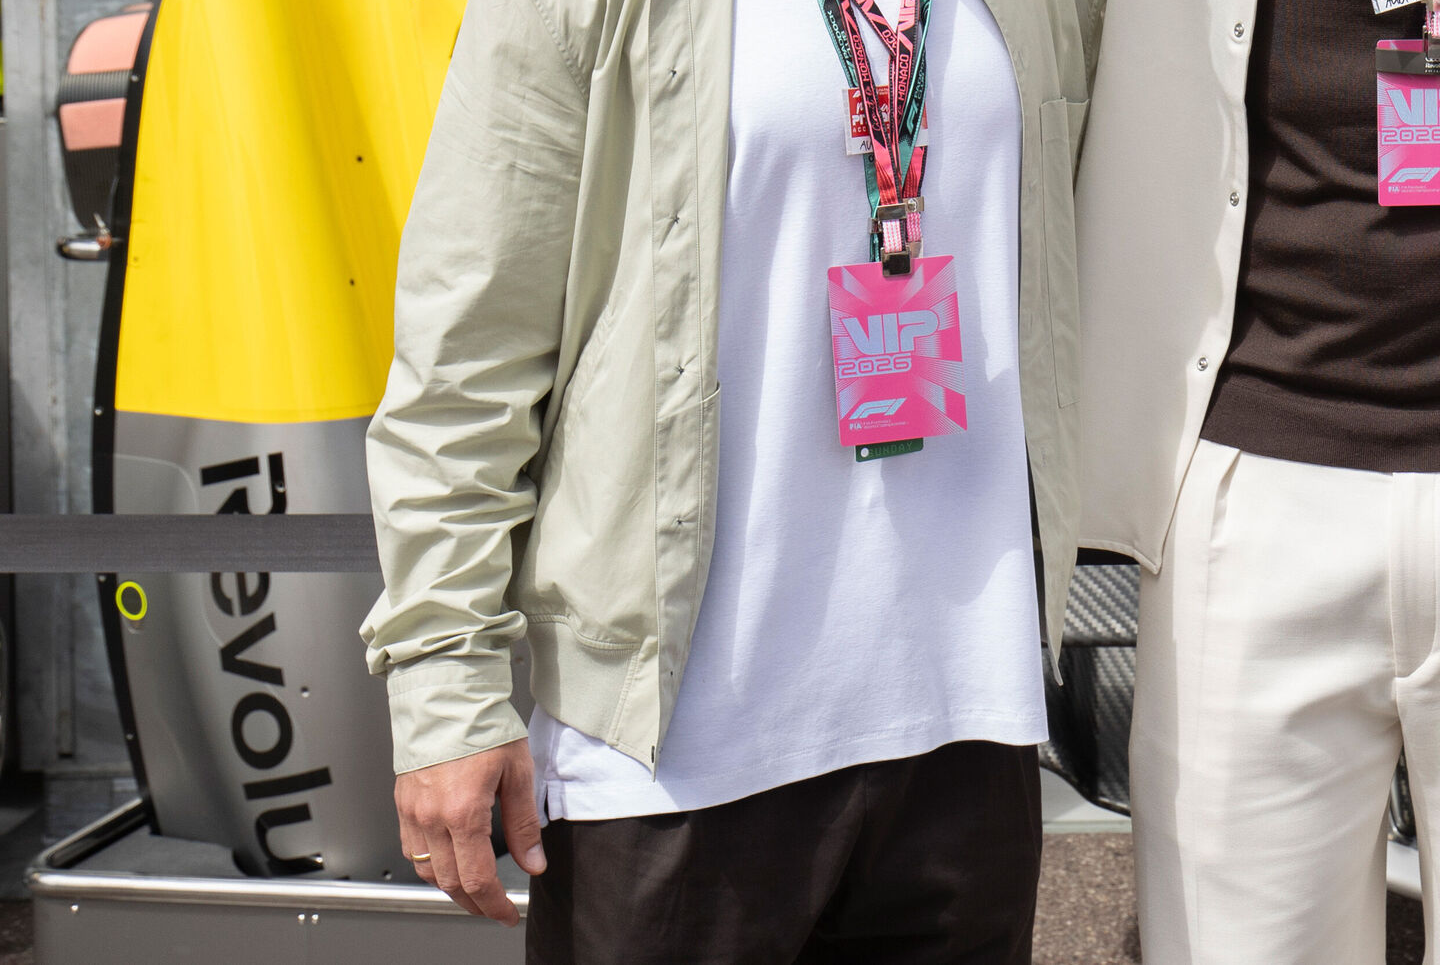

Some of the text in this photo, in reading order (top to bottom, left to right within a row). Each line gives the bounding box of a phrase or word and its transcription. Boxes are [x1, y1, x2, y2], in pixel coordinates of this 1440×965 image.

[897, 54, 910, 101] MONACO
[841, 309, 939, 356] VIP
[838, 352, 912, 380] 2026
[200, 452, 332, 877] Revolu
